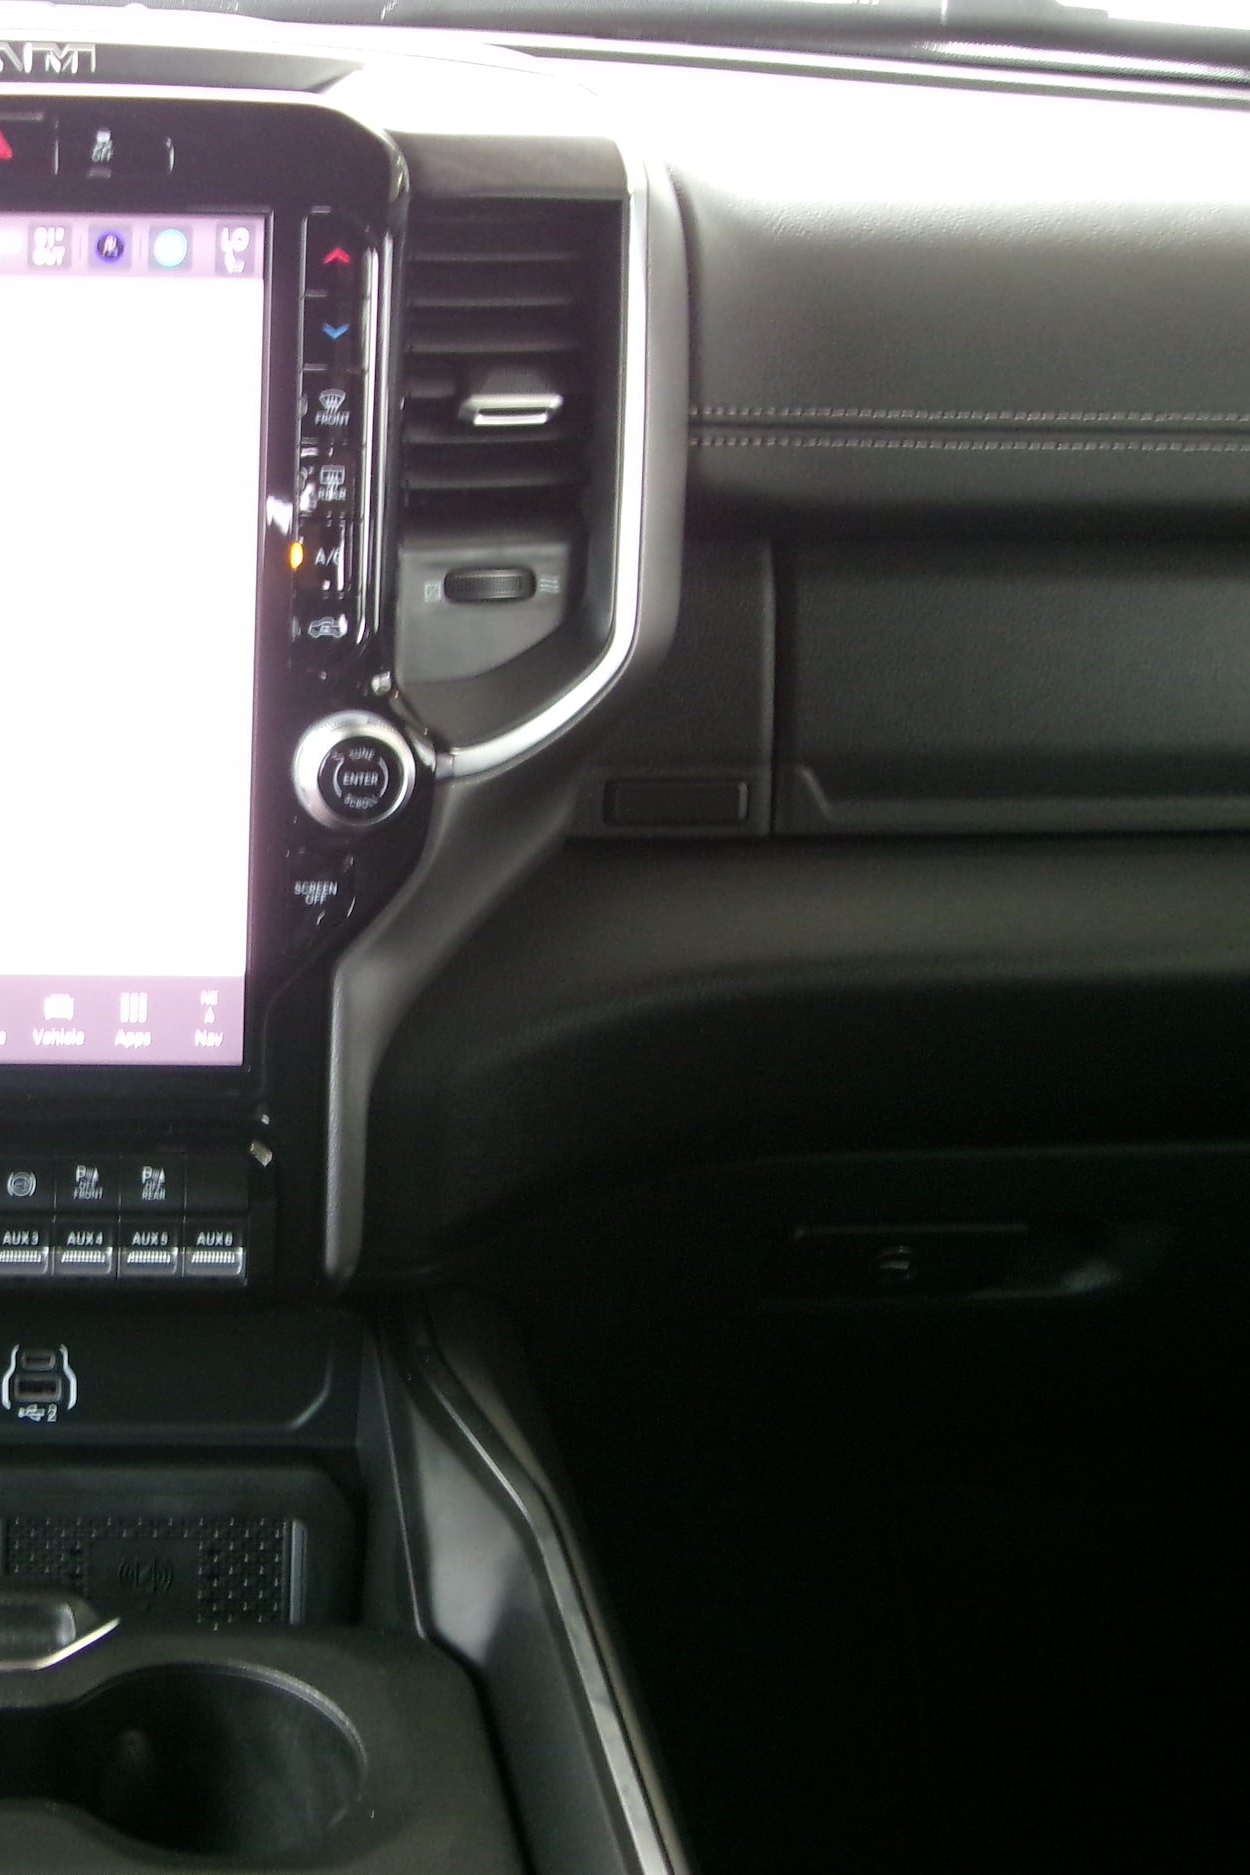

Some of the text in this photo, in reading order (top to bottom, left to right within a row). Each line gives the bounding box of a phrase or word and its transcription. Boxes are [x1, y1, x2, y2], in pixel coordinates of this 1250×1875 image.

[343, 771, 379, 786] ENTER
[294, 880, 338, 896] SCREEN
[305, 893, 327, 905] OFF
[32, 1027, 85, 1047] Vehicle
[114, 1028, 152, 1050] Apps
[194, 1028, 224, 1048] Nav
[2, 1231, 39, 1246] AUX 3
[67, 1231, 103, 1246] AUX 4
[132, 1231, 159, 1246] AUX
[196, 1232, 224, 1247] AUX
[46, 1403, 58, 1422] 2
